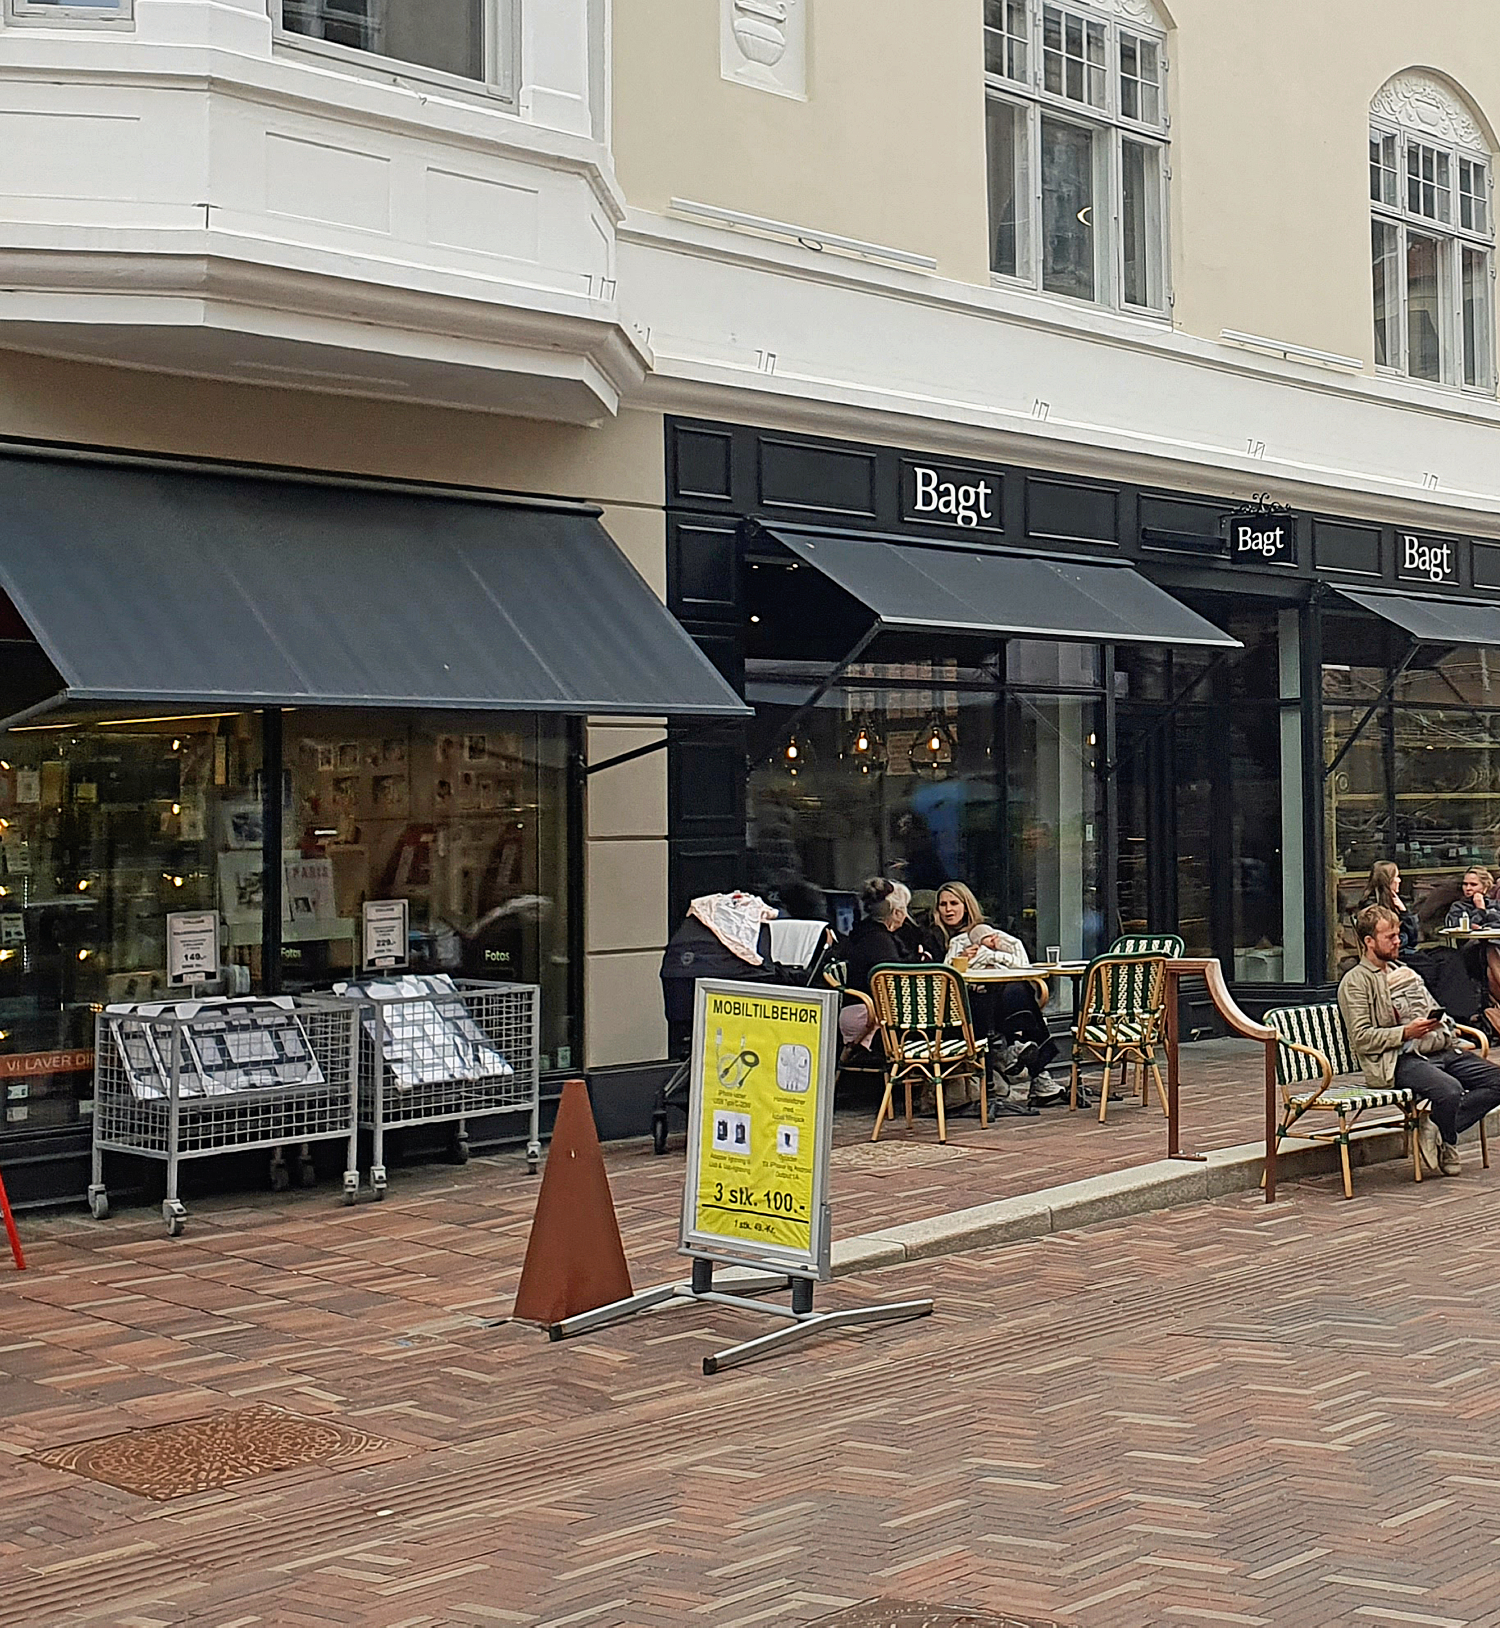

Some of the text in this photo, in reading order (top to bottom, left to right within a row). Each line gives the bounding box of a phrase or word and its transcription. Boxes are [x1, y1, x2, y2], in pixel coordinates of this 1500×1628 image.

[913, 467, 992, 527] Bagt
[1237, 526, 1285, 556] Bagt
[1403, 536, 1452, 581] Bagt
[485, 949, 510, 961] Fotos
[713, 999, 818, 1024] MOBILTILBEHØR
[7, 1061, 20, 1071] VI
[25, 1054, 72, 1070] LAVER
[714, 1182, 723, 1201] 3
[728, 1187, 757, 1206] stk.
